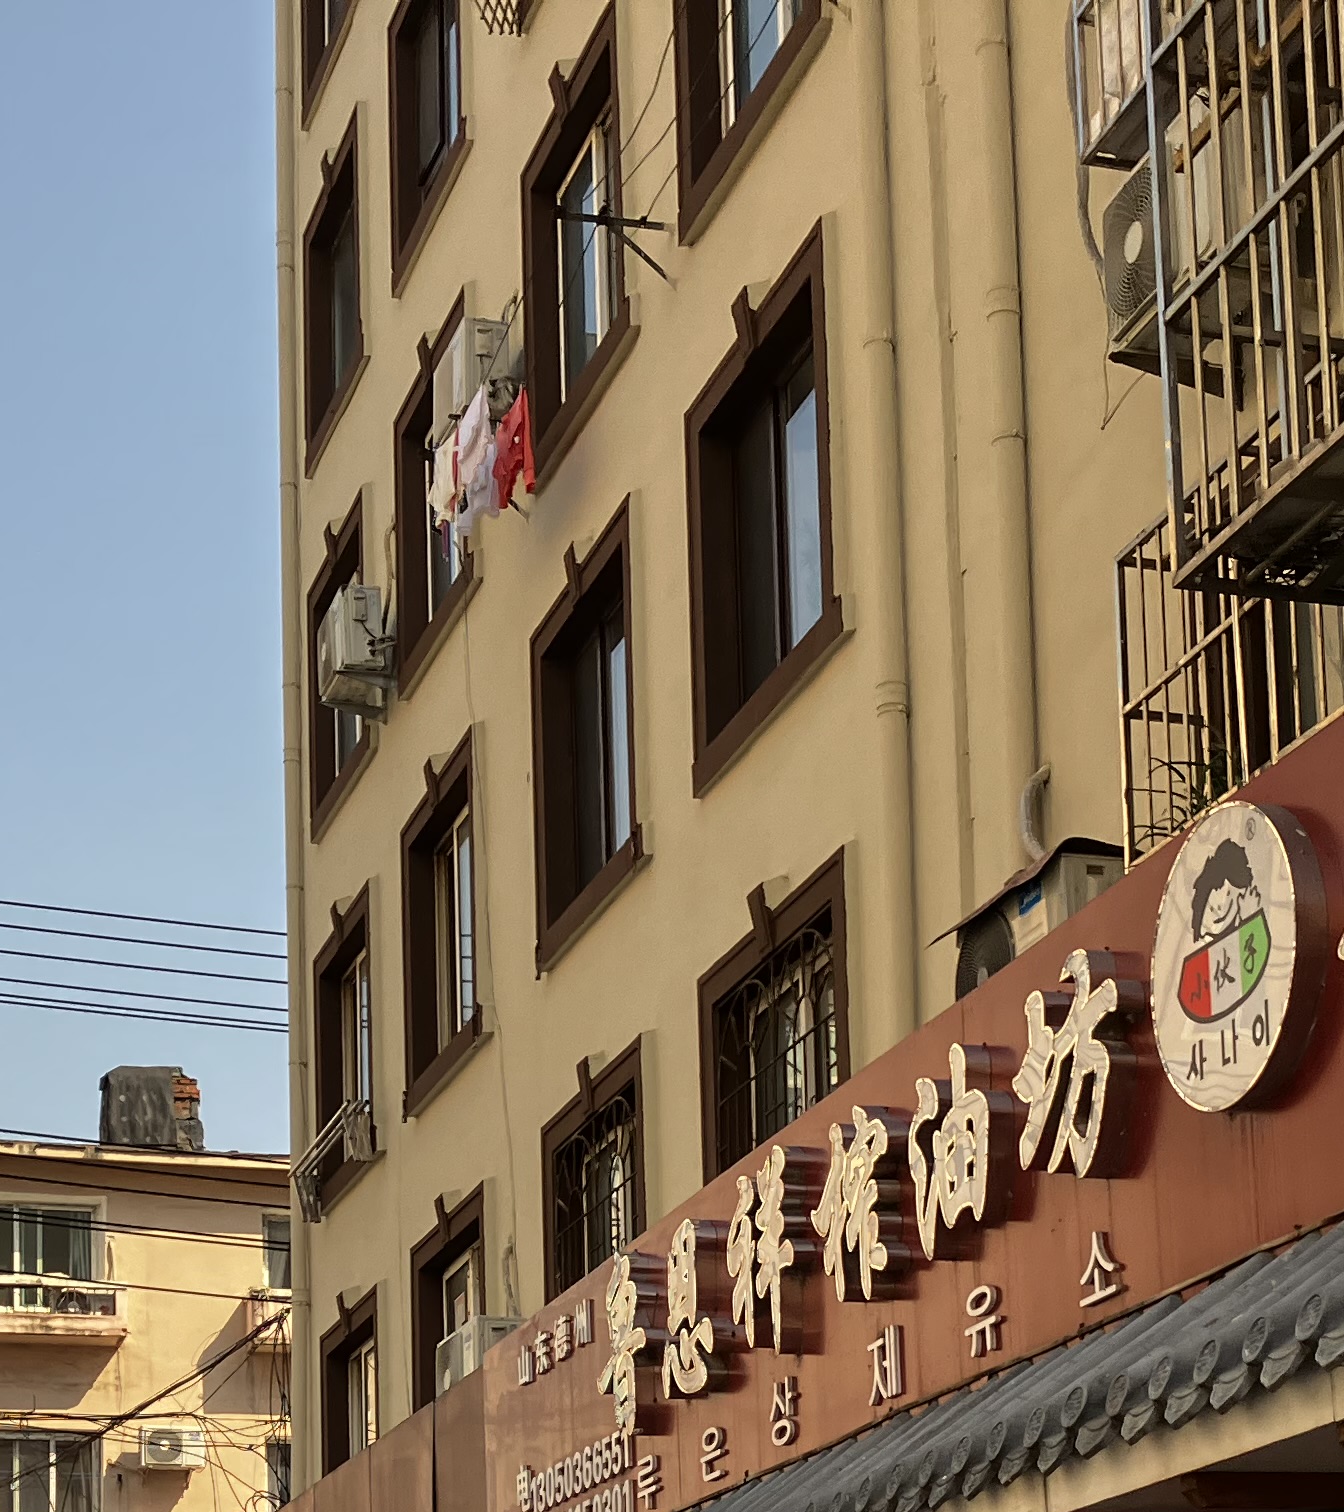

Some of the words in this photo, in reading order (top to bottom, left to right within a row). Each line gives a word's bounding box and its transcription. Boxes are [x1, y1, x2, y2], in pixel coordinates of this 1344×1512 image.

[1190, 933, 1257, 1003] 小伙子
[1186, 999, 1270, 1081] 사나이
